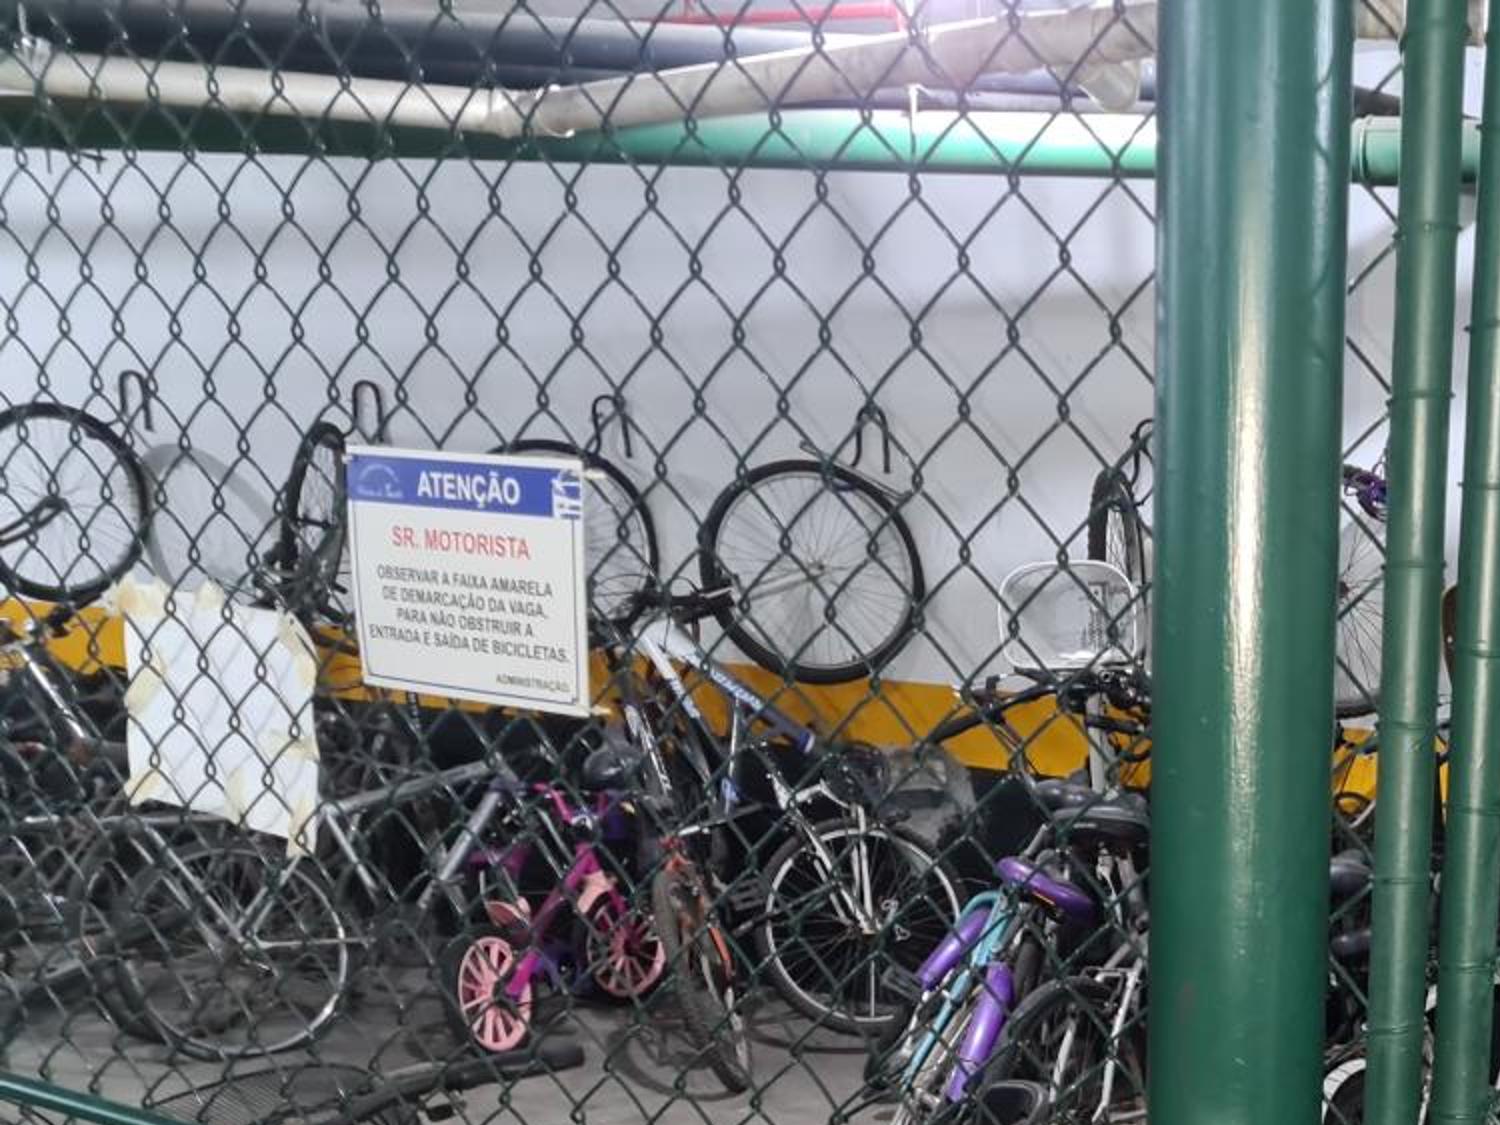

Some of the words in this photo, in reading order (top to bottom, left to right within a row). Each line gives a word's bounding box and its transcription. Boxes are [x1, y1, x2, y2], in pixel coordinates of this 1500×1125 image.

[417, 470, 521, 508] ATENÇÃO
[392, 526, 419, 548] SR.
[424, 529, 531, 560] MOTORISTA
[377, 564, 439, 583] OBSERVAR
[441, 572, 450, 584] A
[453, 572, 488, 590] FAIXA
[490, 577, 554, 598] AMARELA
[382, 585, 397, 600] DE
[400, 587, 486, 612] DEMARCAÇÃO
[488, 598, 508, 614] DA
[369, 623, 421, 642] ENTRADA
[423, 630, 431, 645] E
[433, 630, 470, 649] SAÍDA
[472, 637, 490, 653] DE
[397, 607, 428, 624] PARA
[430, 609, 455, 629] NÃO
[458, 615, 523, 636] OBSTRUIR
[525, 622, 534, 637] A
